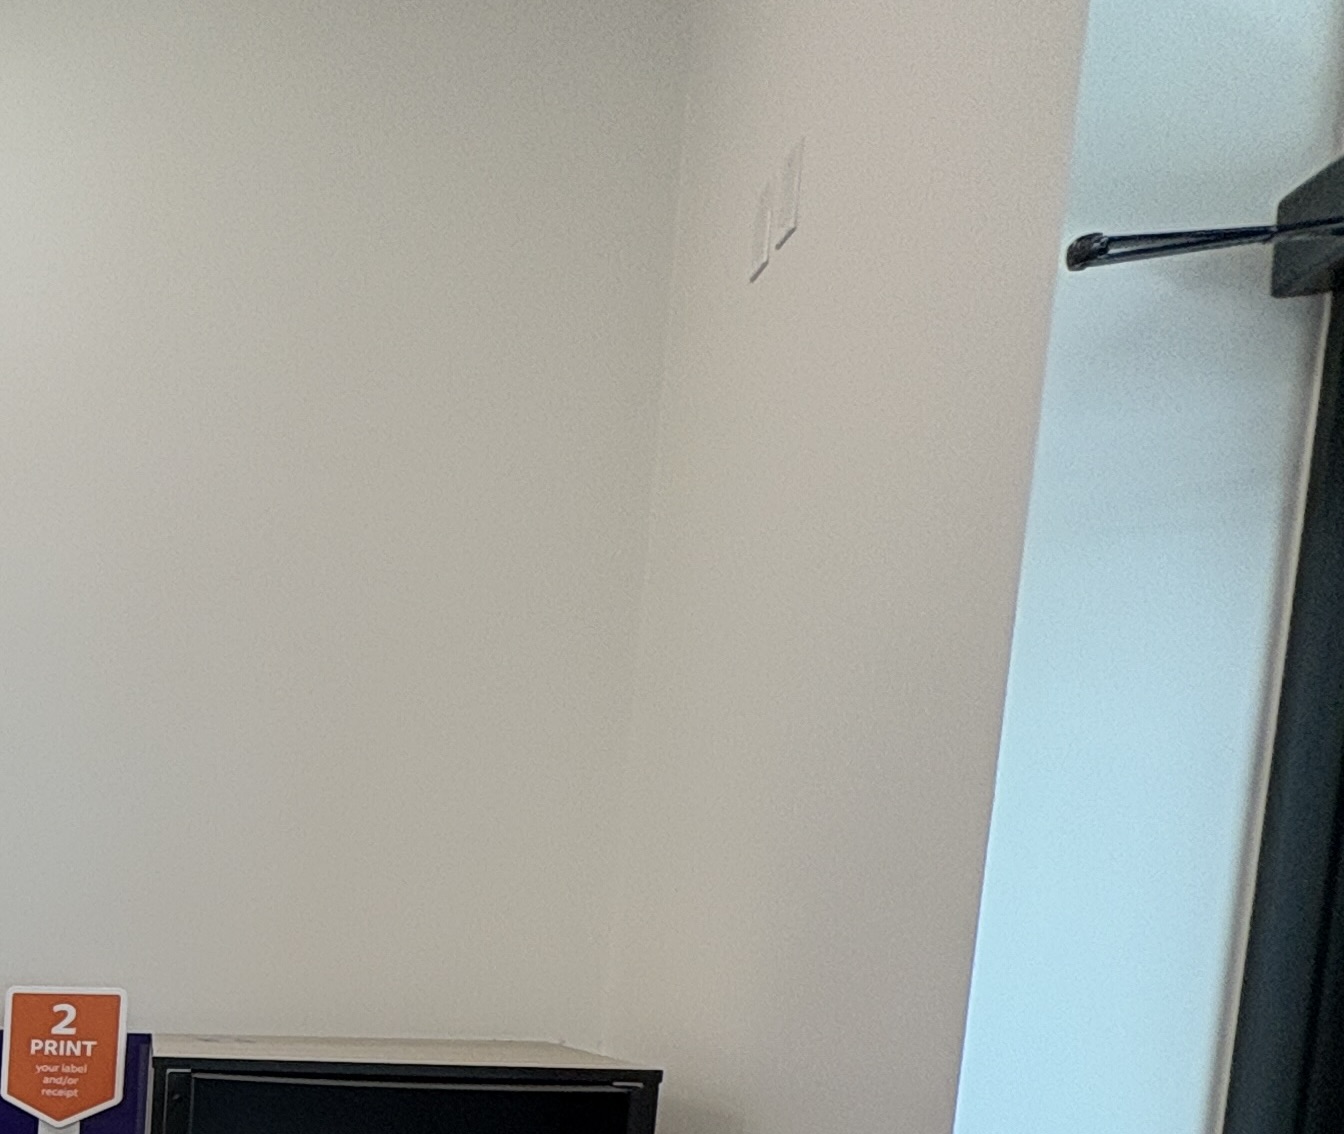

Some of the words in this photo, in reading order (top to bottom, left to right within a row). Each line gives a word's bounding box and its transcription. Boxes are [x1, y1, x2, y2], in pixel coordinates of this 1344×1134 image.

[50, 1003, 77, 1035] 2
[30, 1039, 97, 1057] PRINT
[35, 1064, 59, 1074] your
[61, 1064, 87, 1074] label
[43, 1075, 79, 1086] and/or
[41, 1088, 78, 1099] receipt
